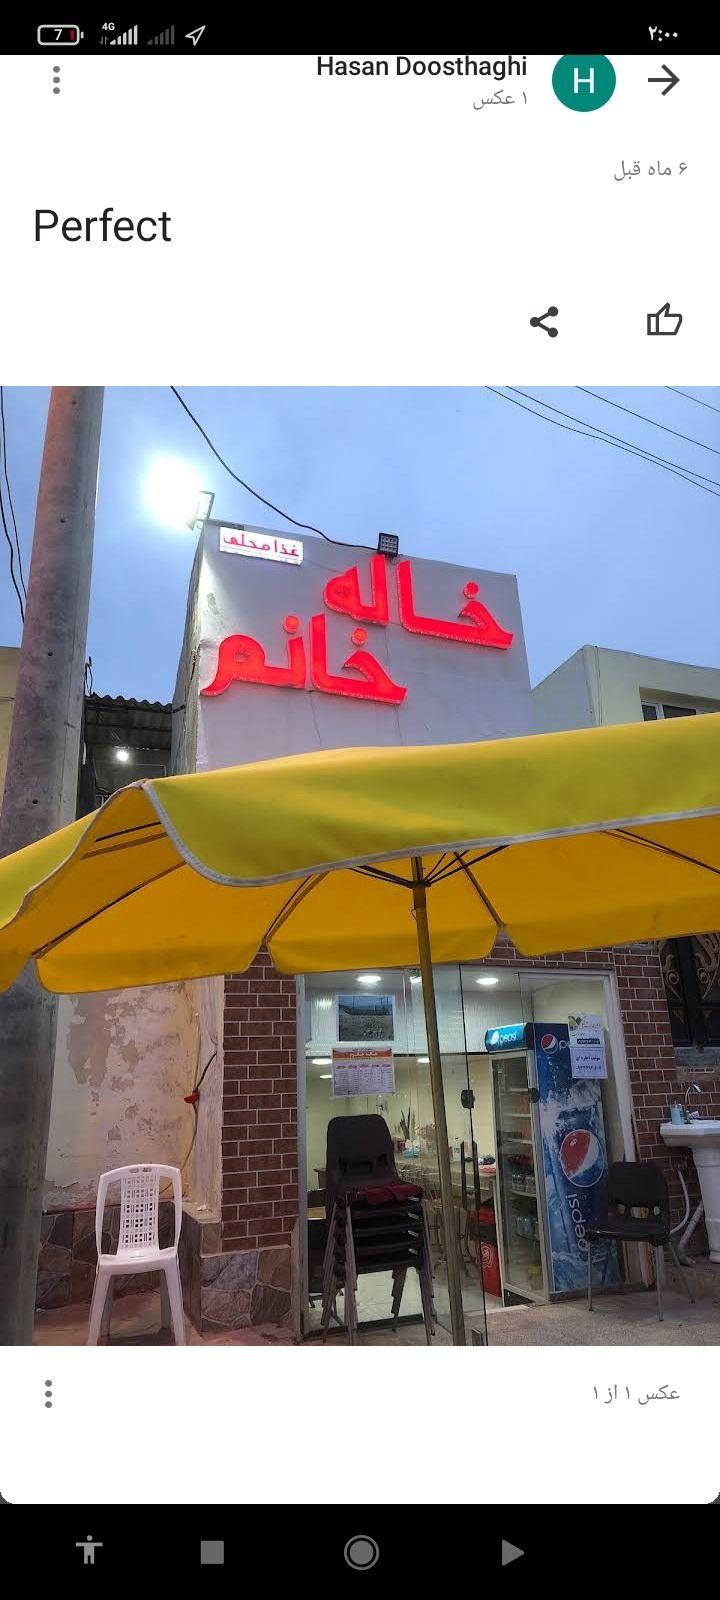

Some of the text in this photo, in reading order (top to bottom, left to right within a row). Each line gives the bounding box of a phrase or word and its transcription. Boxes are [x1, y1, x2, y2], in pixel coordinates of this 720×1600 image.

[274, 540, 299, 557] غذا
[324, 554, 514, 650] خاله
[200, 613, 408, 705] خانم
[565, 1193, 590, 1252] pepsi
